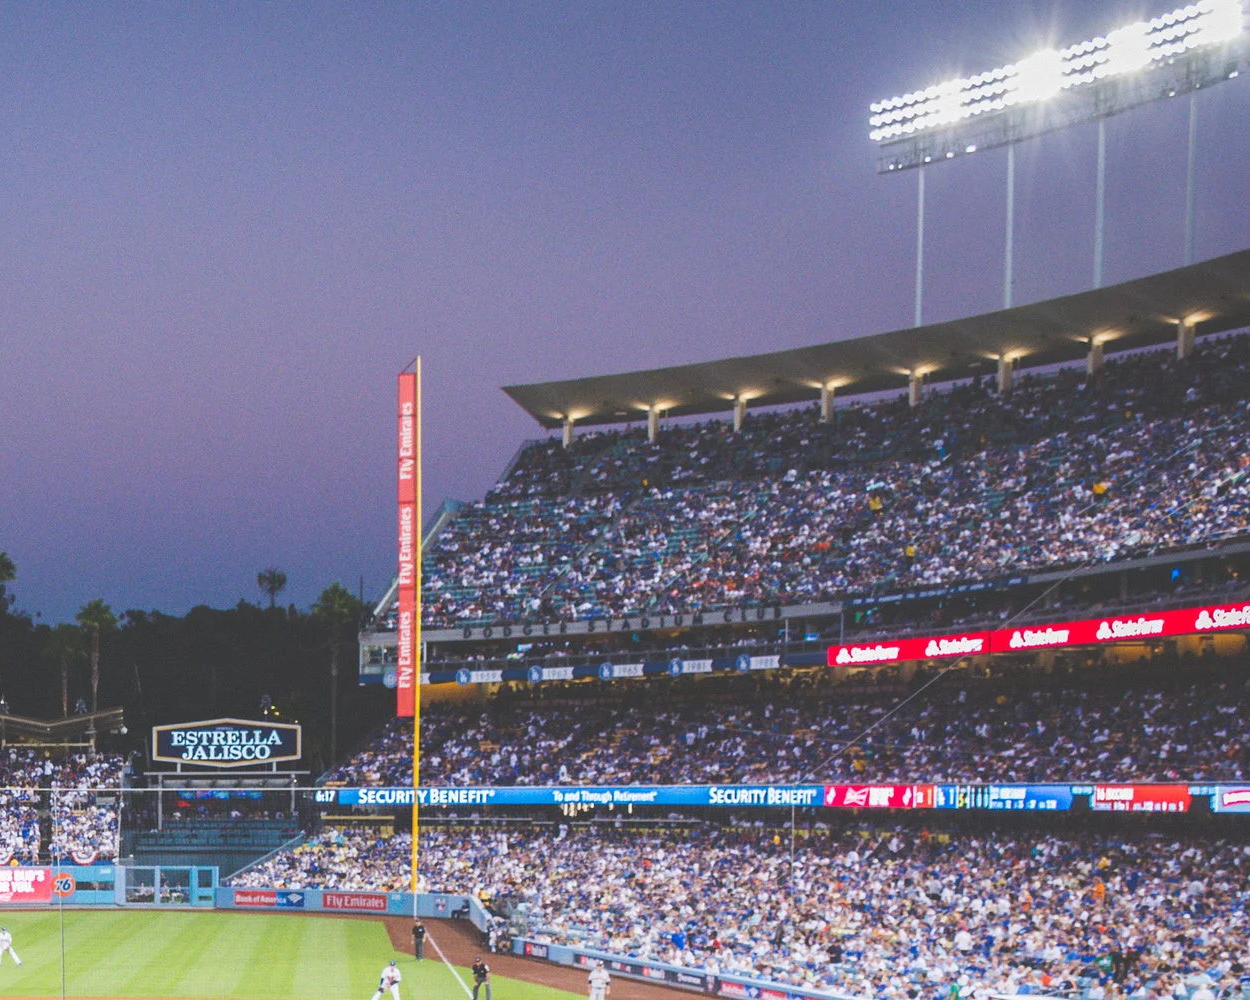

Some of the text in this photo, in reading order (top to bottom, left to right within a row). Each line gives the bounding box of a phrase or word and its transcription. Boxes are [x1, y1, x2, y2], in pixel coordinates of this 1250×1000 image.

[399, 506, 413, 585] Fly Emirates
[398, 611, 413, 689] Fly Emirates
[171, 730, 282, 746] ESTRELLA
[182, 745, 271, 760] JALISCO
[315, 790, 335, 803] 6:17
[358, 788, 428, 804] SECURITY
[553, 790, 563, 801] To
[709, 787, 767, 804] SECURITY
[54, 878, 71, 891] 76
[327, 894, 342, 909] Fly
[343, 895, 385, 909] Emirates
